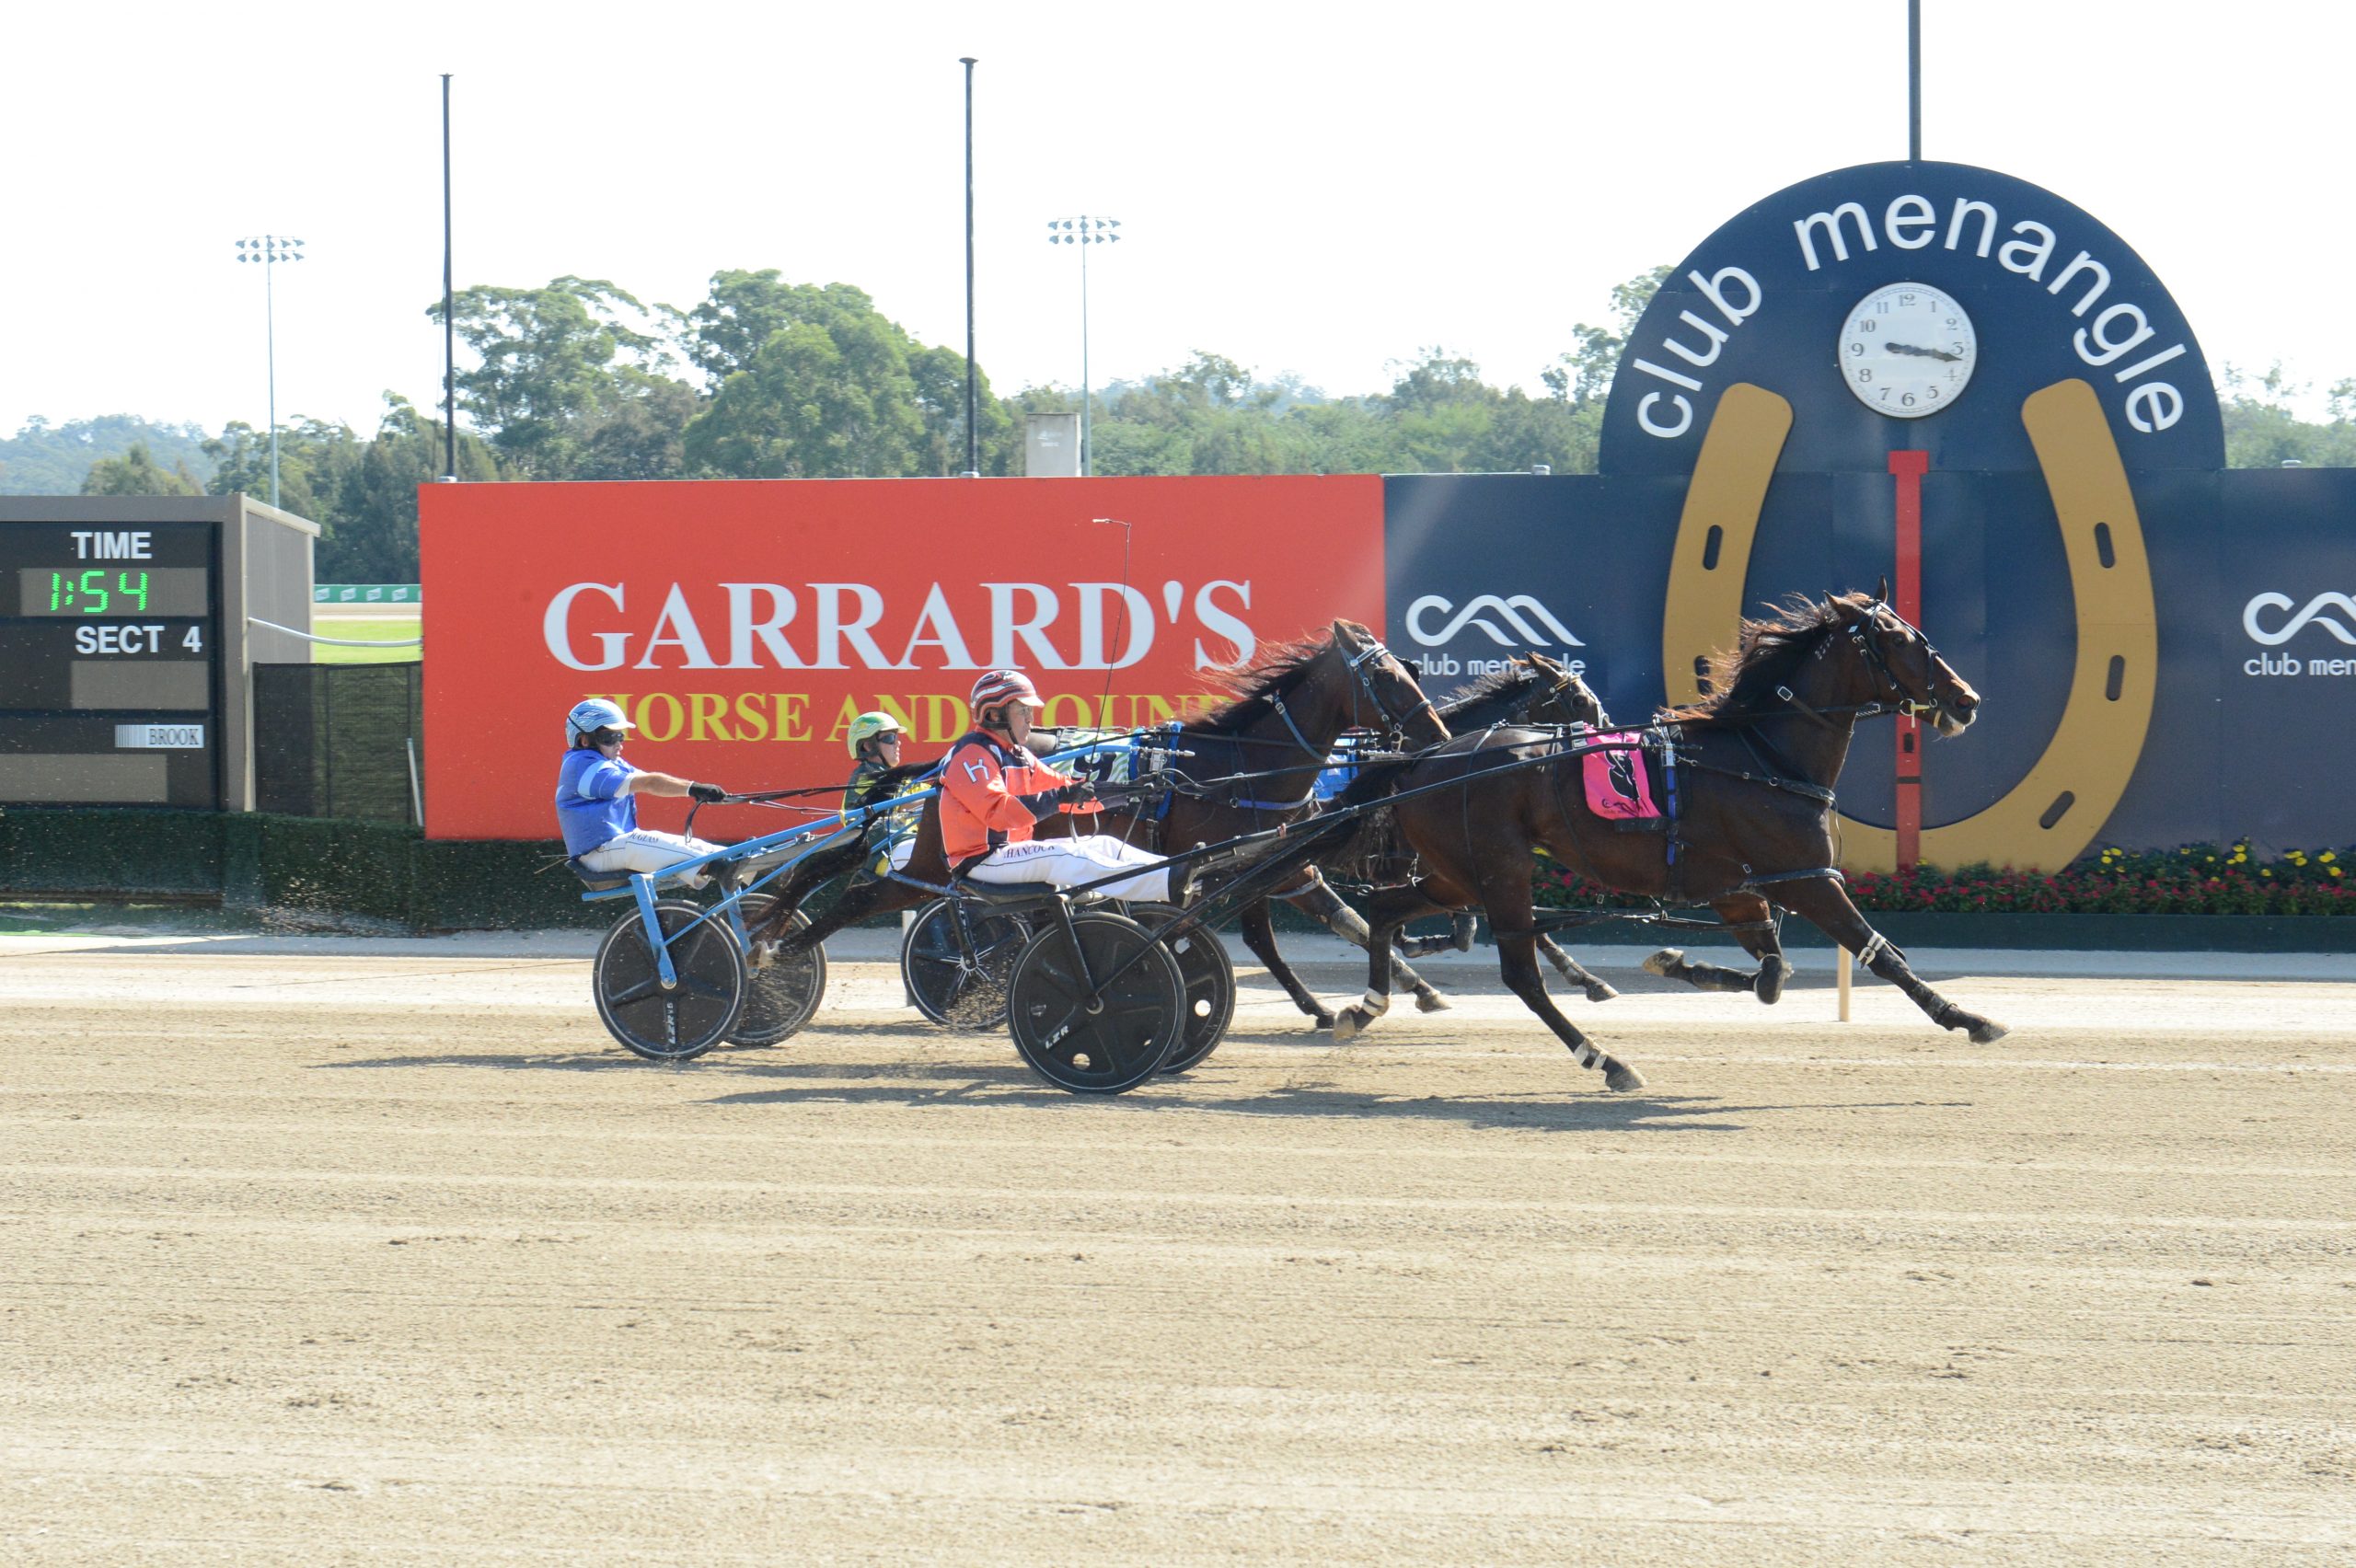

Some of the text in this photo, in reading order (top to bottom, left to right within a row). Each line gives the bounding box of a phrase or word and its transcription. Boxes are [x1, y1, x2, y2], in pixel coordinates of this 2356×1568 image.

[1899, 294, 1916, 306] 12
[1930, 301, 1937, 313] 1
[1877, 302, 1889, 314] 11
[1632, 194, 2188, 438] club menangle
[1860, 319, 1877, 333] 10
[1946, 318, 1958, 331] 2
[1852, 343, 1865, 357] 9
[1952, 341, 1964, 355] 3
[1859, 368, 1872, 383] 8
[1944, 368, 1958, 382] 4
[1880, 387, 1891, 401] 7
[1901, 392, 1915, 407] 6
[1927, 386, 1939, 399] 5
[70, 531, 153, 559] TIME
[50, 571, 148, 613] 1:54
[542, 580, 1256, 673] GARRARD'S
[75, 625, 202, 654] SECT 4
[2243, 651, 2303, 676] club
[828, 692, 970, 744] AND
[148, 728, 200, 745] BROOK
[1045, 1024, 1069, 1050] LZR
